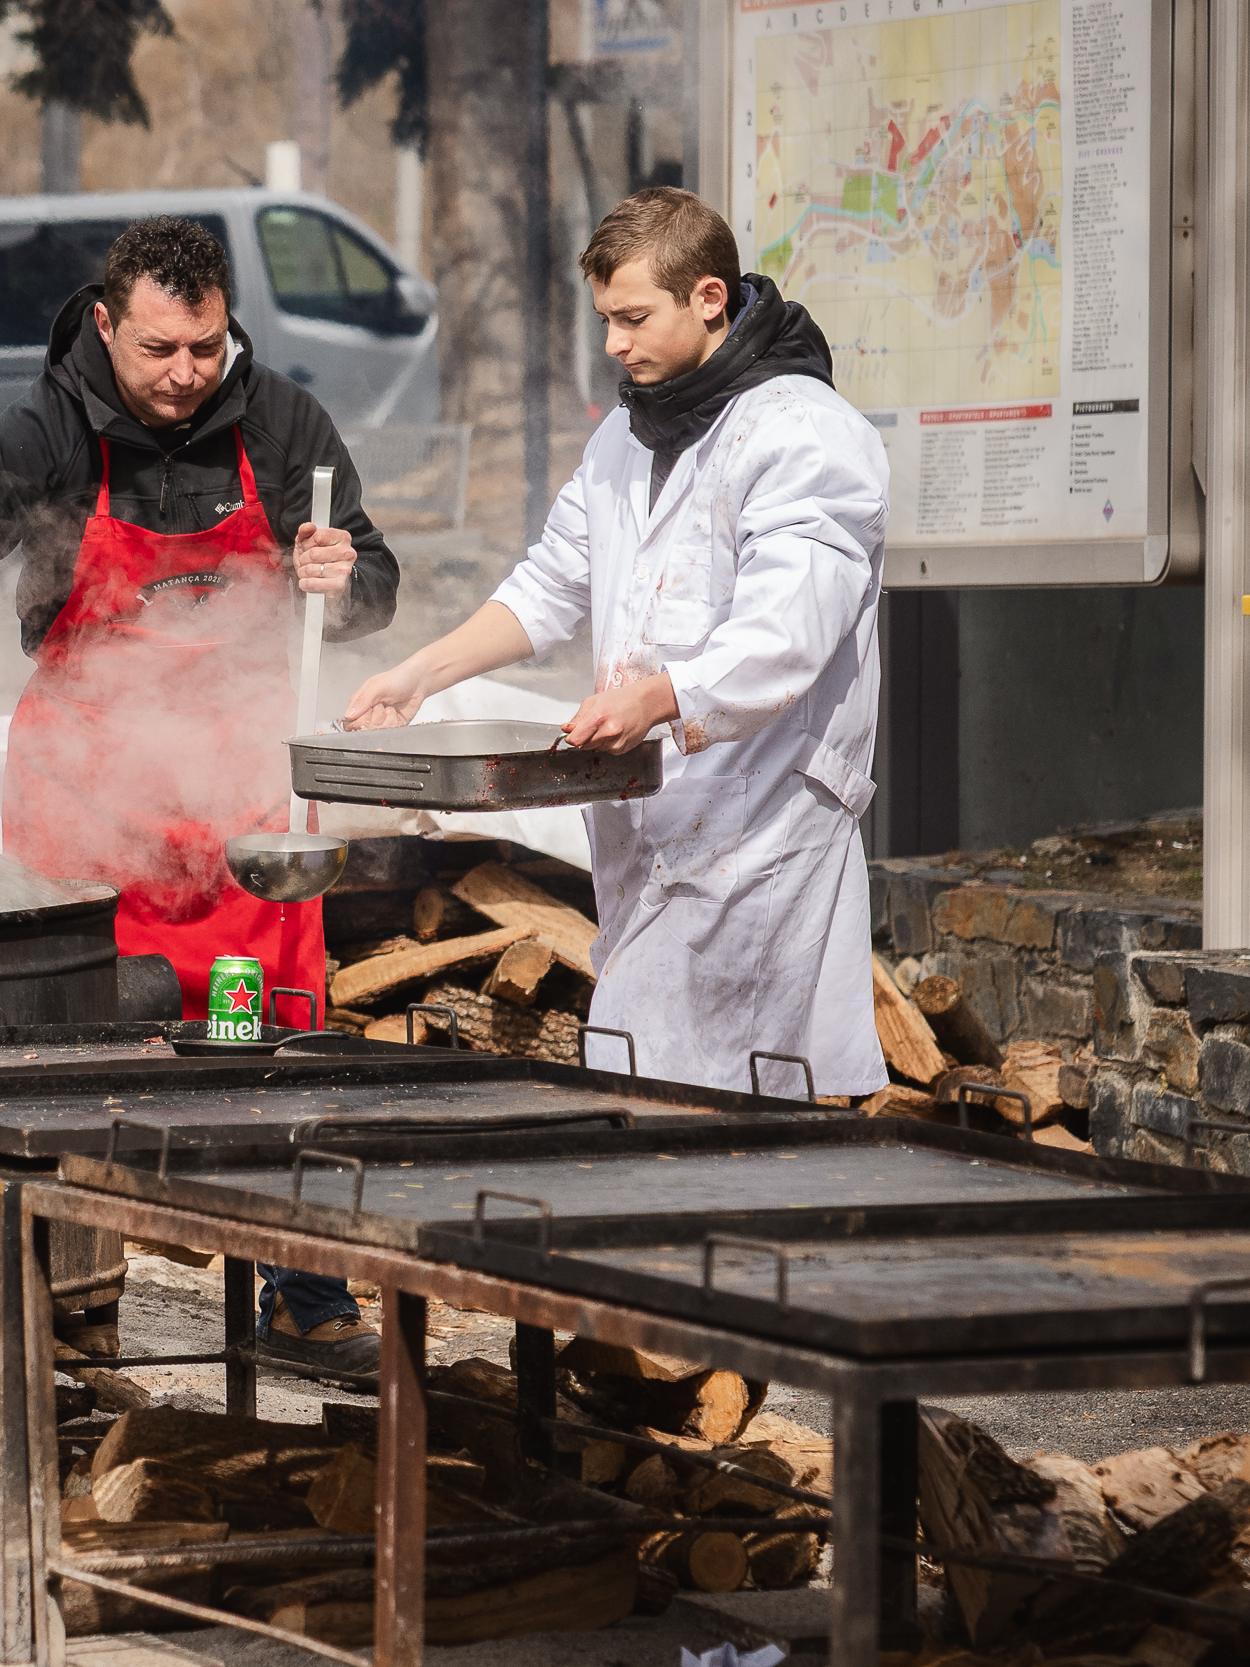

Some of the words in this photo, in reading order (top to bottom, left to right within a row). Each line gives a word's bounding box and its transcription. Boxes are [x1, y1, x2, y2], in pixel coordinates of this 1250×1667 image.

[816, 8, 824, 24] C
[840, 6, 847, 21] D
[153, 576, 200, 591] MATANÇA
[203, 575, 222, 584] 2025
